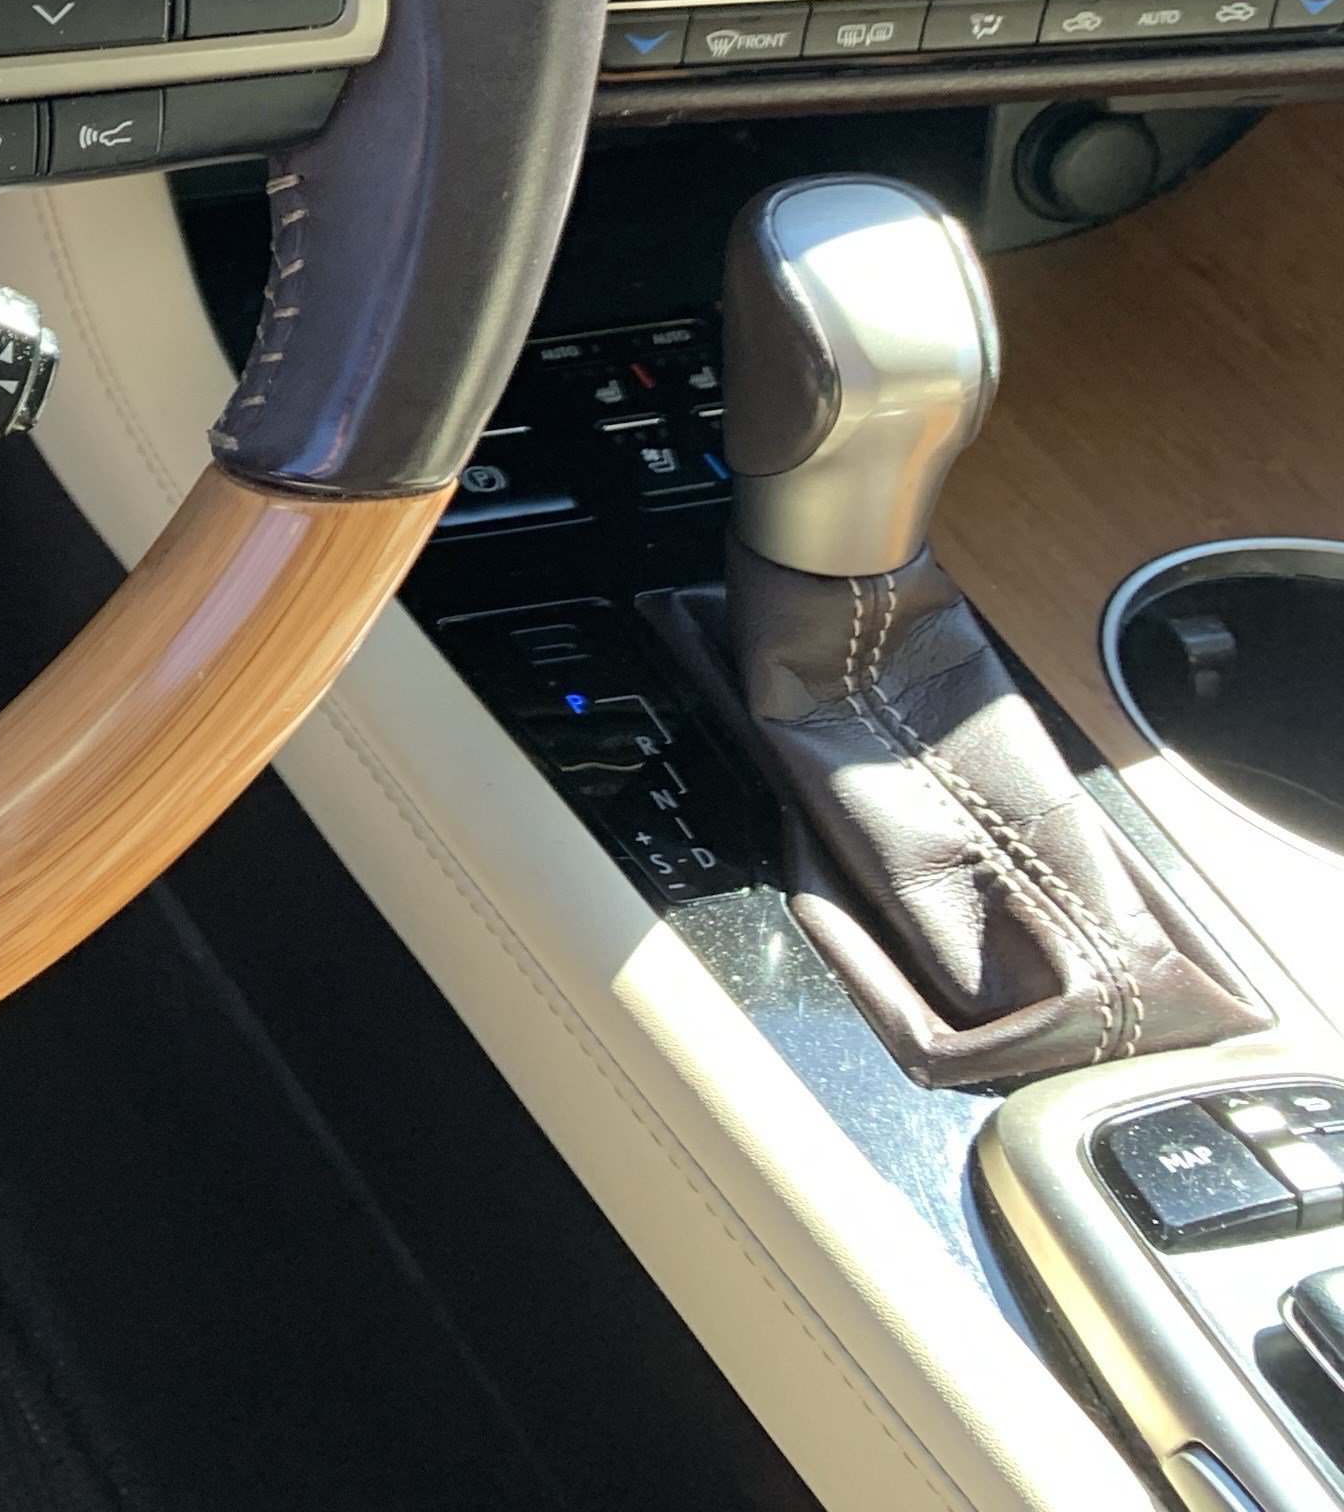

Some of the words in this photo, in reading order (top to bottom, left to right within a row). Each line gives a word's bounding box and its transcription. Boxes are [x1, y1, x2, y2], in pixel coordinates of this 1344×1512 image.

[1137, 9, 1182, 29] AUTO
[736, 31, 788, 52] FRONT
[564, 693, 587, 716] P
[634, 734, 661, 756] R
[649, 788, 679, 811] N
[649, 852, 672, 875] S
[690, 846, 716, 870] D
[1158, 1146, 1213, 1173] MAP
